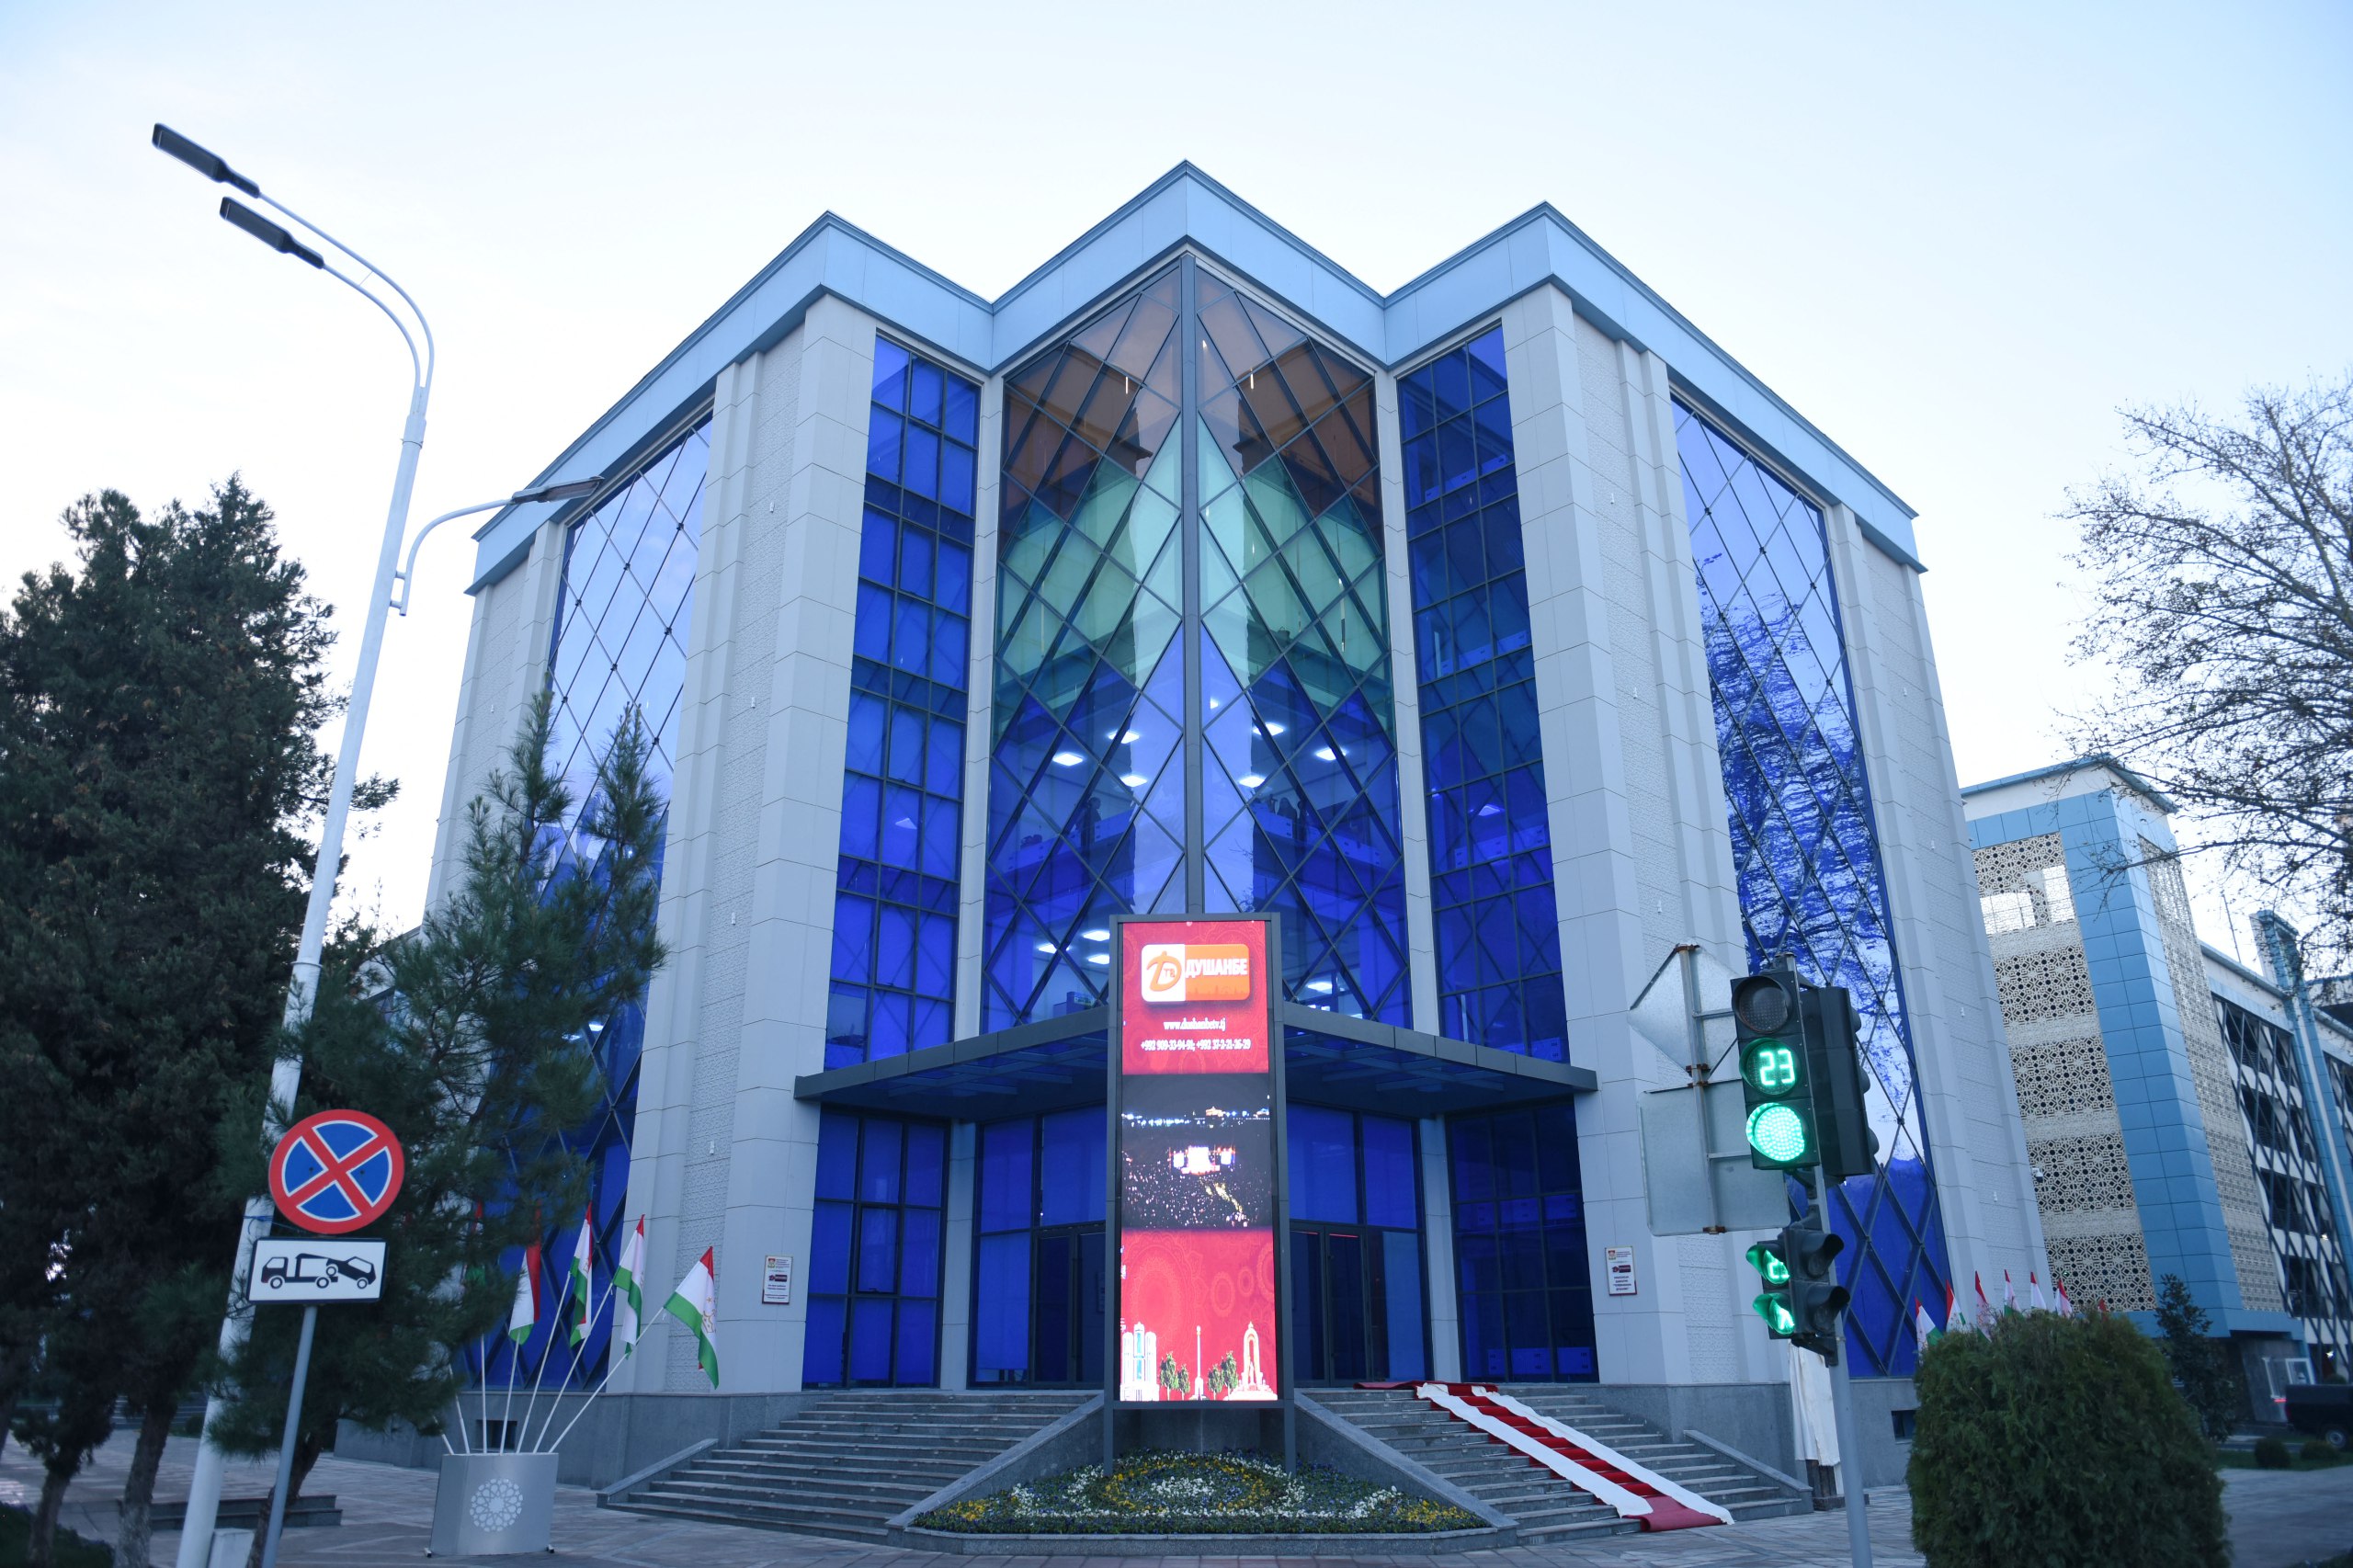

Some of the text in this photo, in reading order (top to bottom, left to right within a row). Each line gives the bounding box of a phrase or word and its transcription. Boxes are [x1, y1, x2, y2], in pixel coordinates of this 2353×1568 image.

[1185, 958, 1248, 978] ДУШАНБЕ
[1141, 1040, 1156, 1051] +992
[1196, 1039, 1211, 1050] +992
[1759, 1049, 1796, 1085] 23
